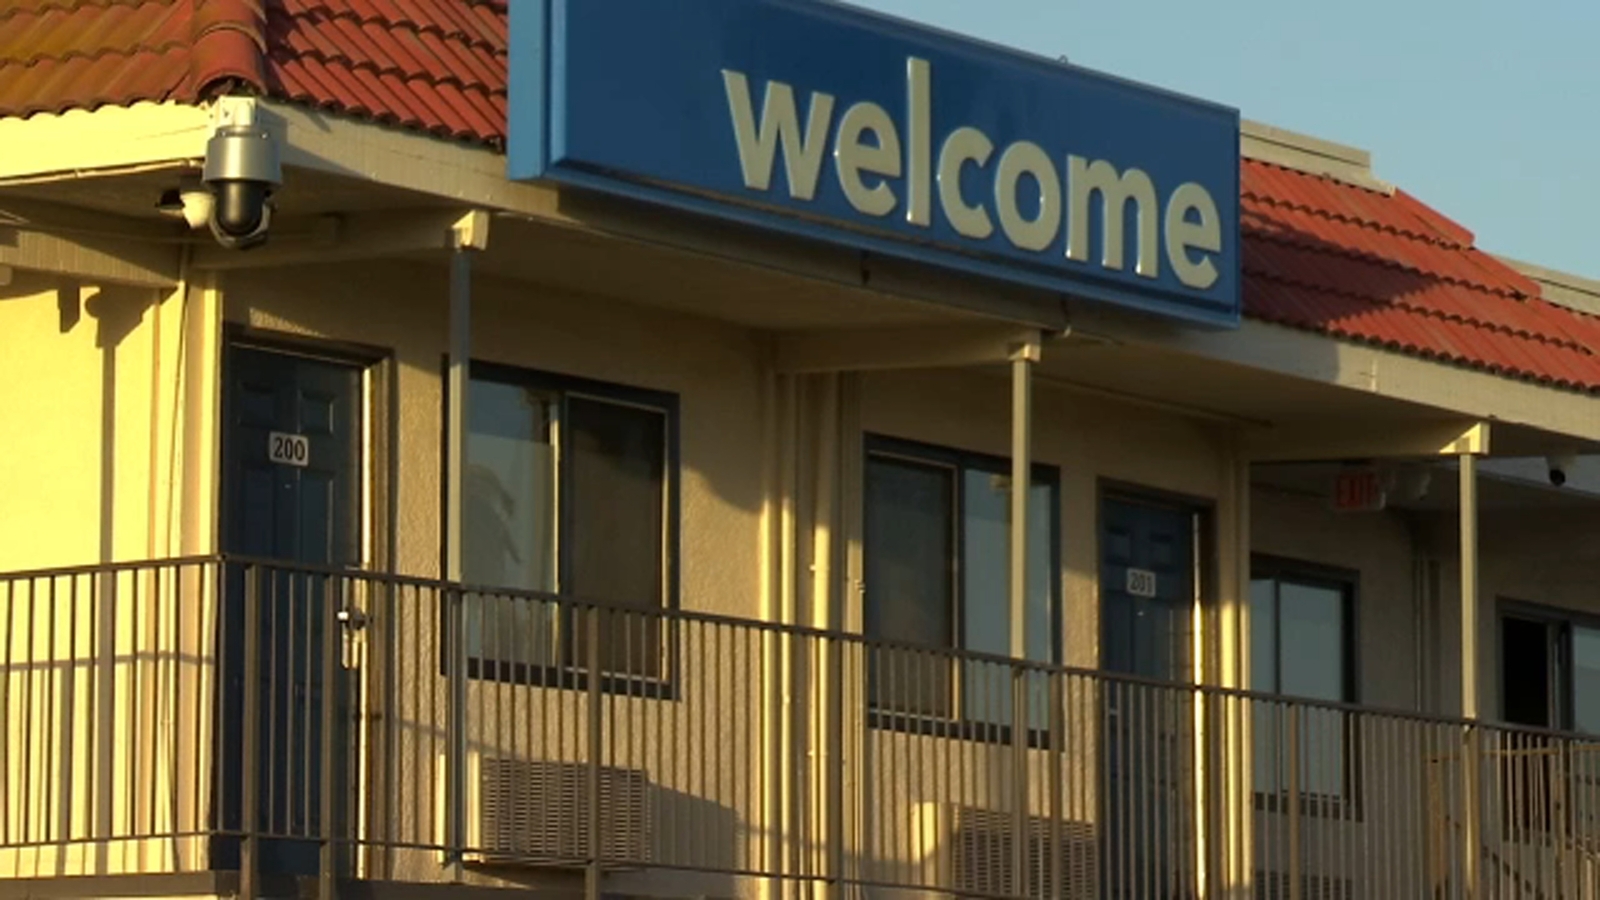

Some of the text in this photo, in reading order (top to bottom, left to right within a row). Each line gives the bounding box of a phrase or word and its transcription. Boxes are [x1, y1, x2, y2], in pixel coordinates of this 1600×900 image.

[721, 56, 1222, 290] welcome
[273, 436, 306, 462] 200
[1130, 571, 1153, 594] 201
